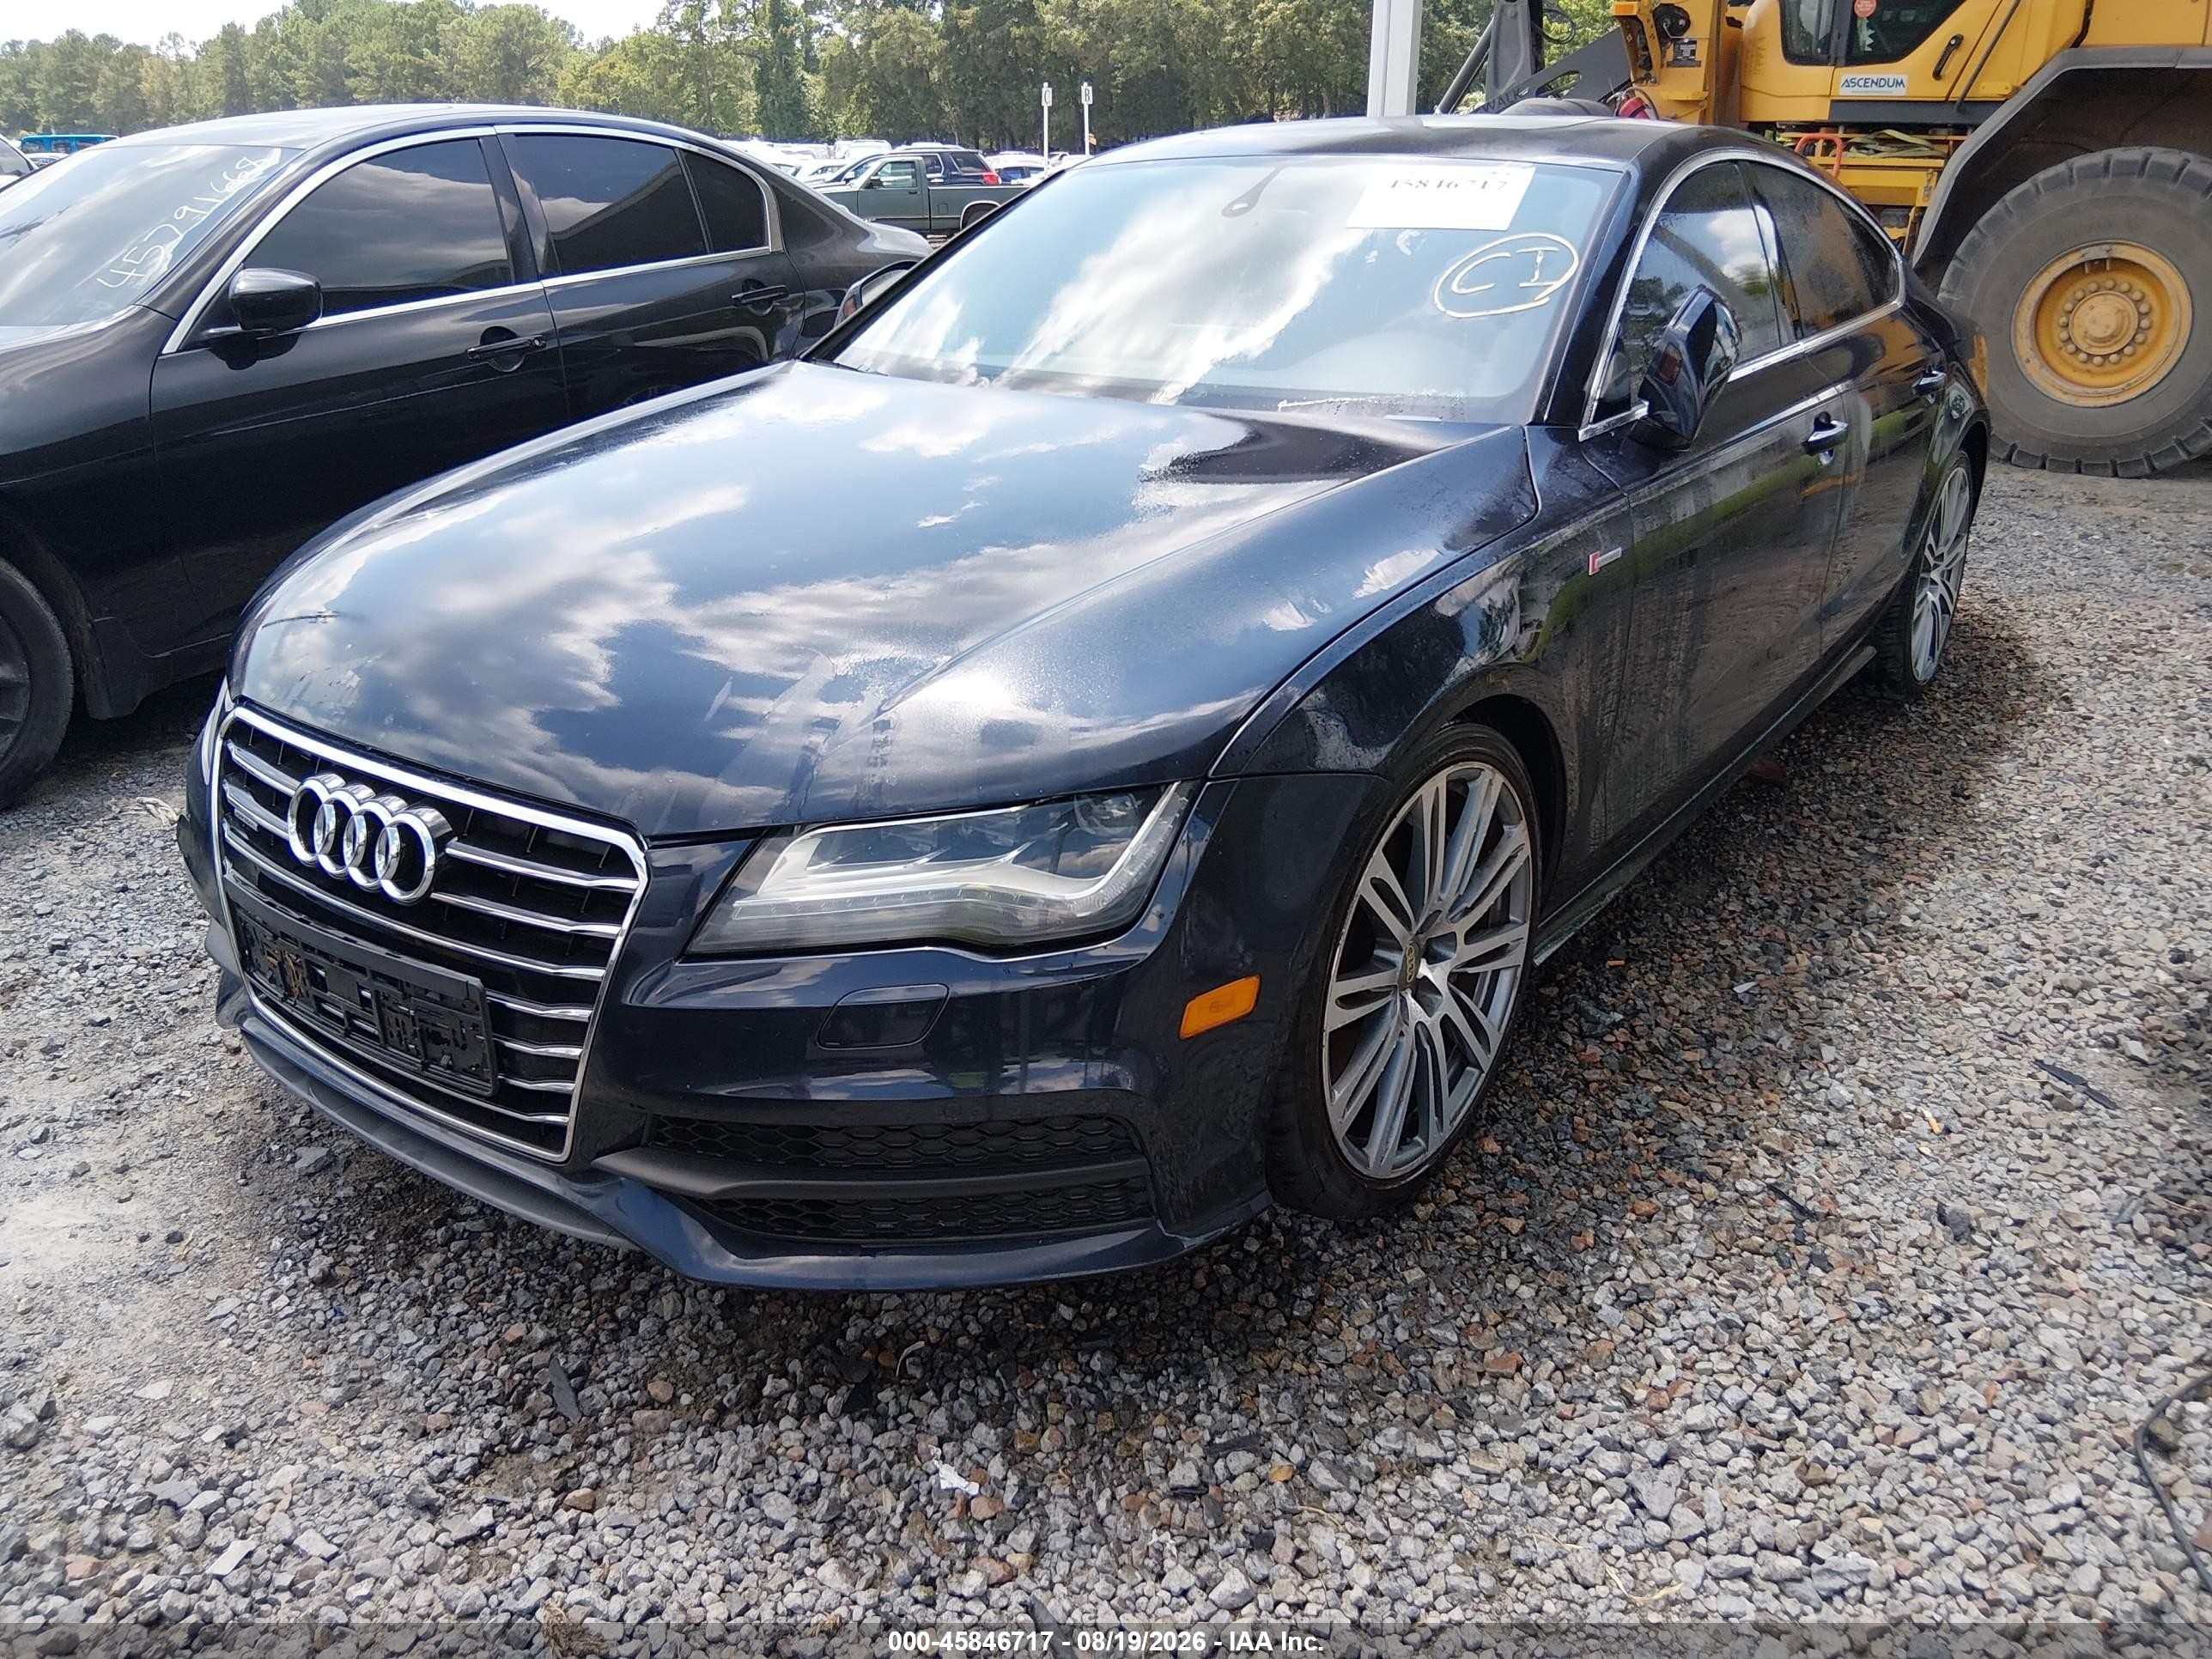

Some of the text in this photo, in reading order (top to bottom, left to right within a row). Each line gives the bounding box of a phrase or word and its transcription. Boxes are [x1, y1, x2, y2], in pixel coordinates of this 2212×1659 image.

[1841, 77, 1905, 88] ASCENDUM
[1044, 89, 1050, 104] C
[1085, 88, 1091, 101] B
